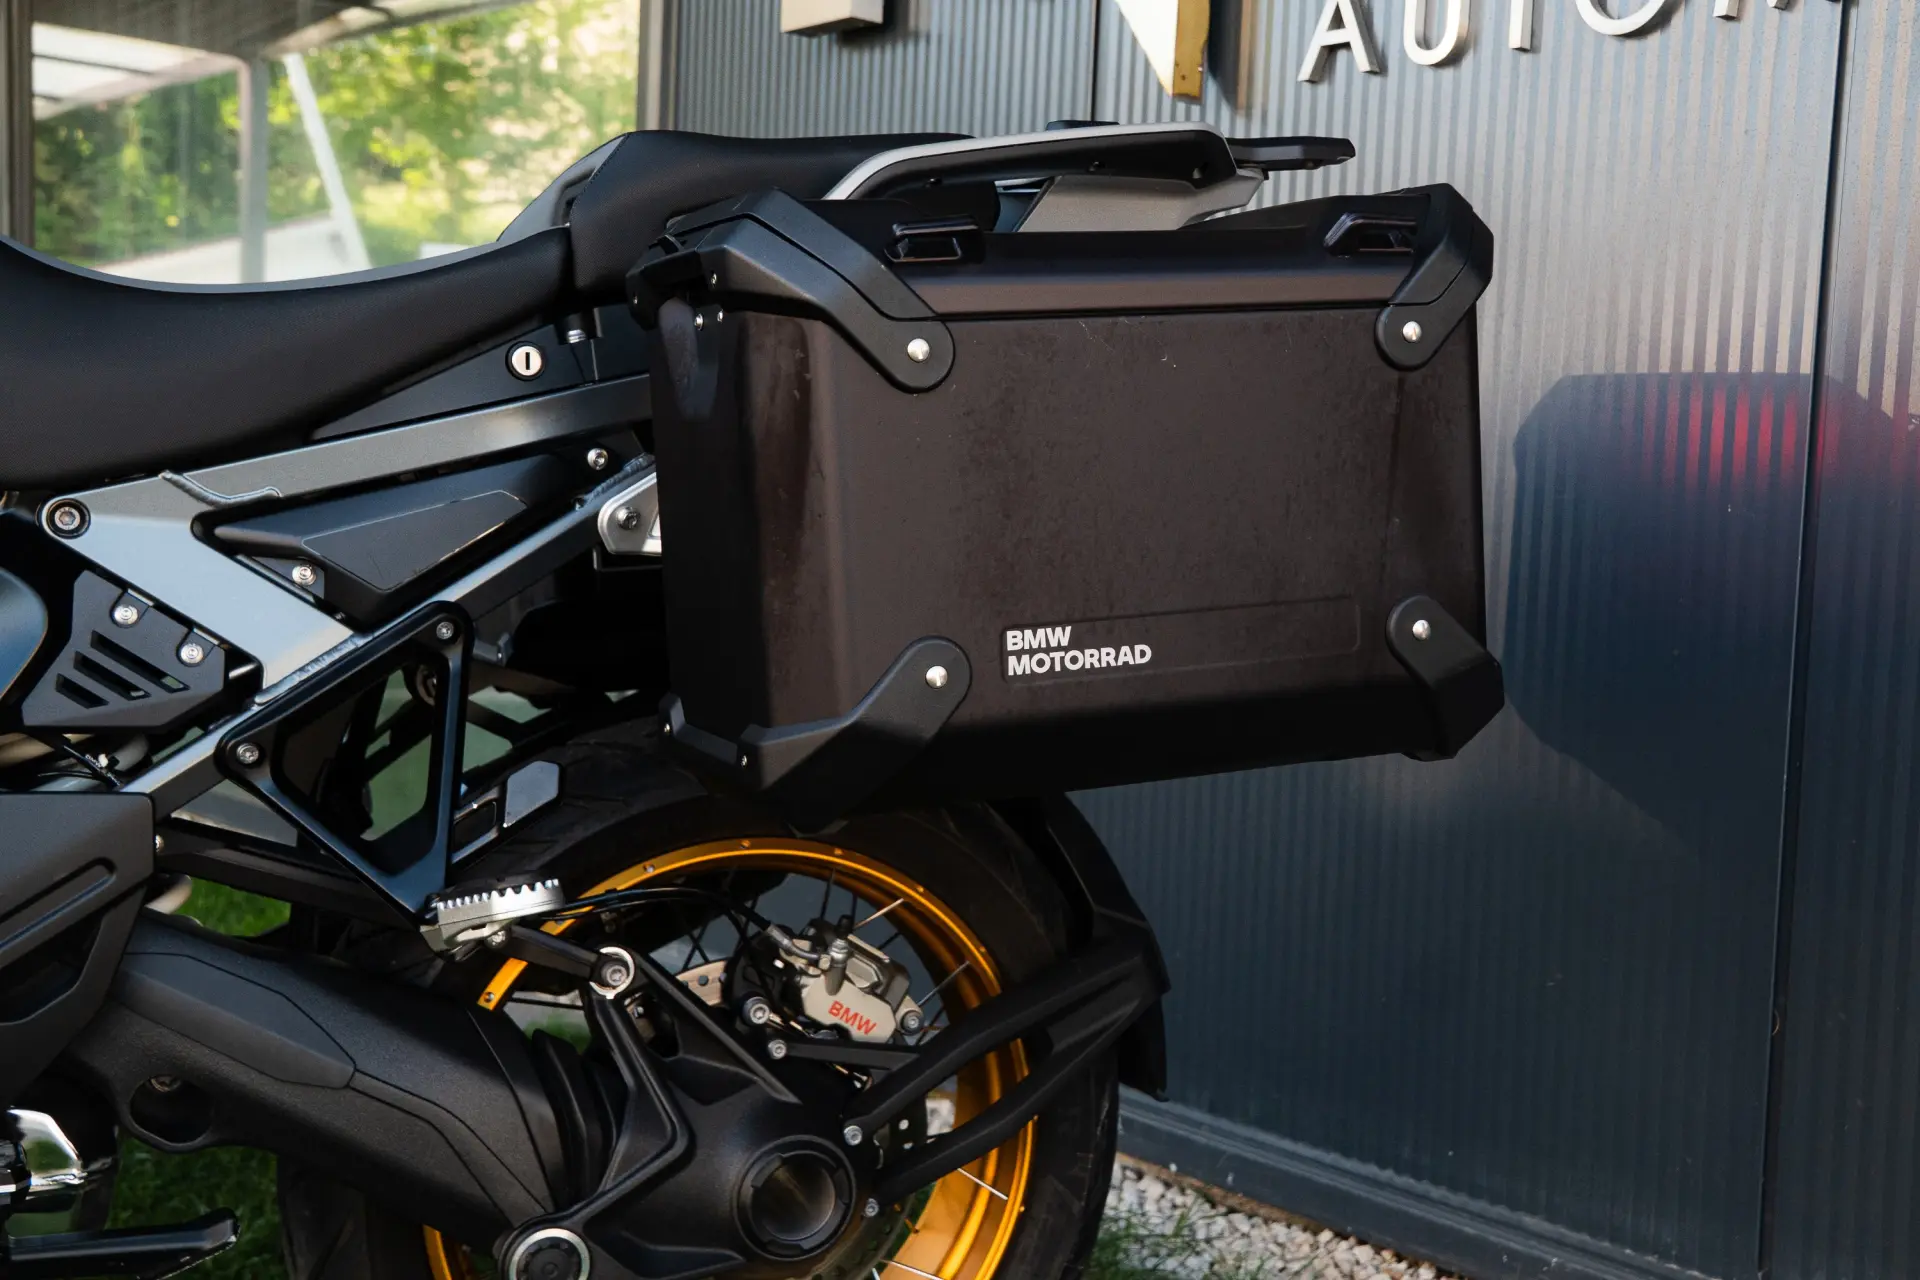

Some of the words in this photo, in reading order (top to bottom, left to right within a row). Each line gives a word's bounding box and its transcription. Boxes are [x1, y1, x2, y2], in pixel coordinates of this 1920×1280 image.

[1006, 625, 1072, 651] BMW
[1007, 644, 1152, 676] MOTORRAD
[828, 1000, 877, 1035] BMW
